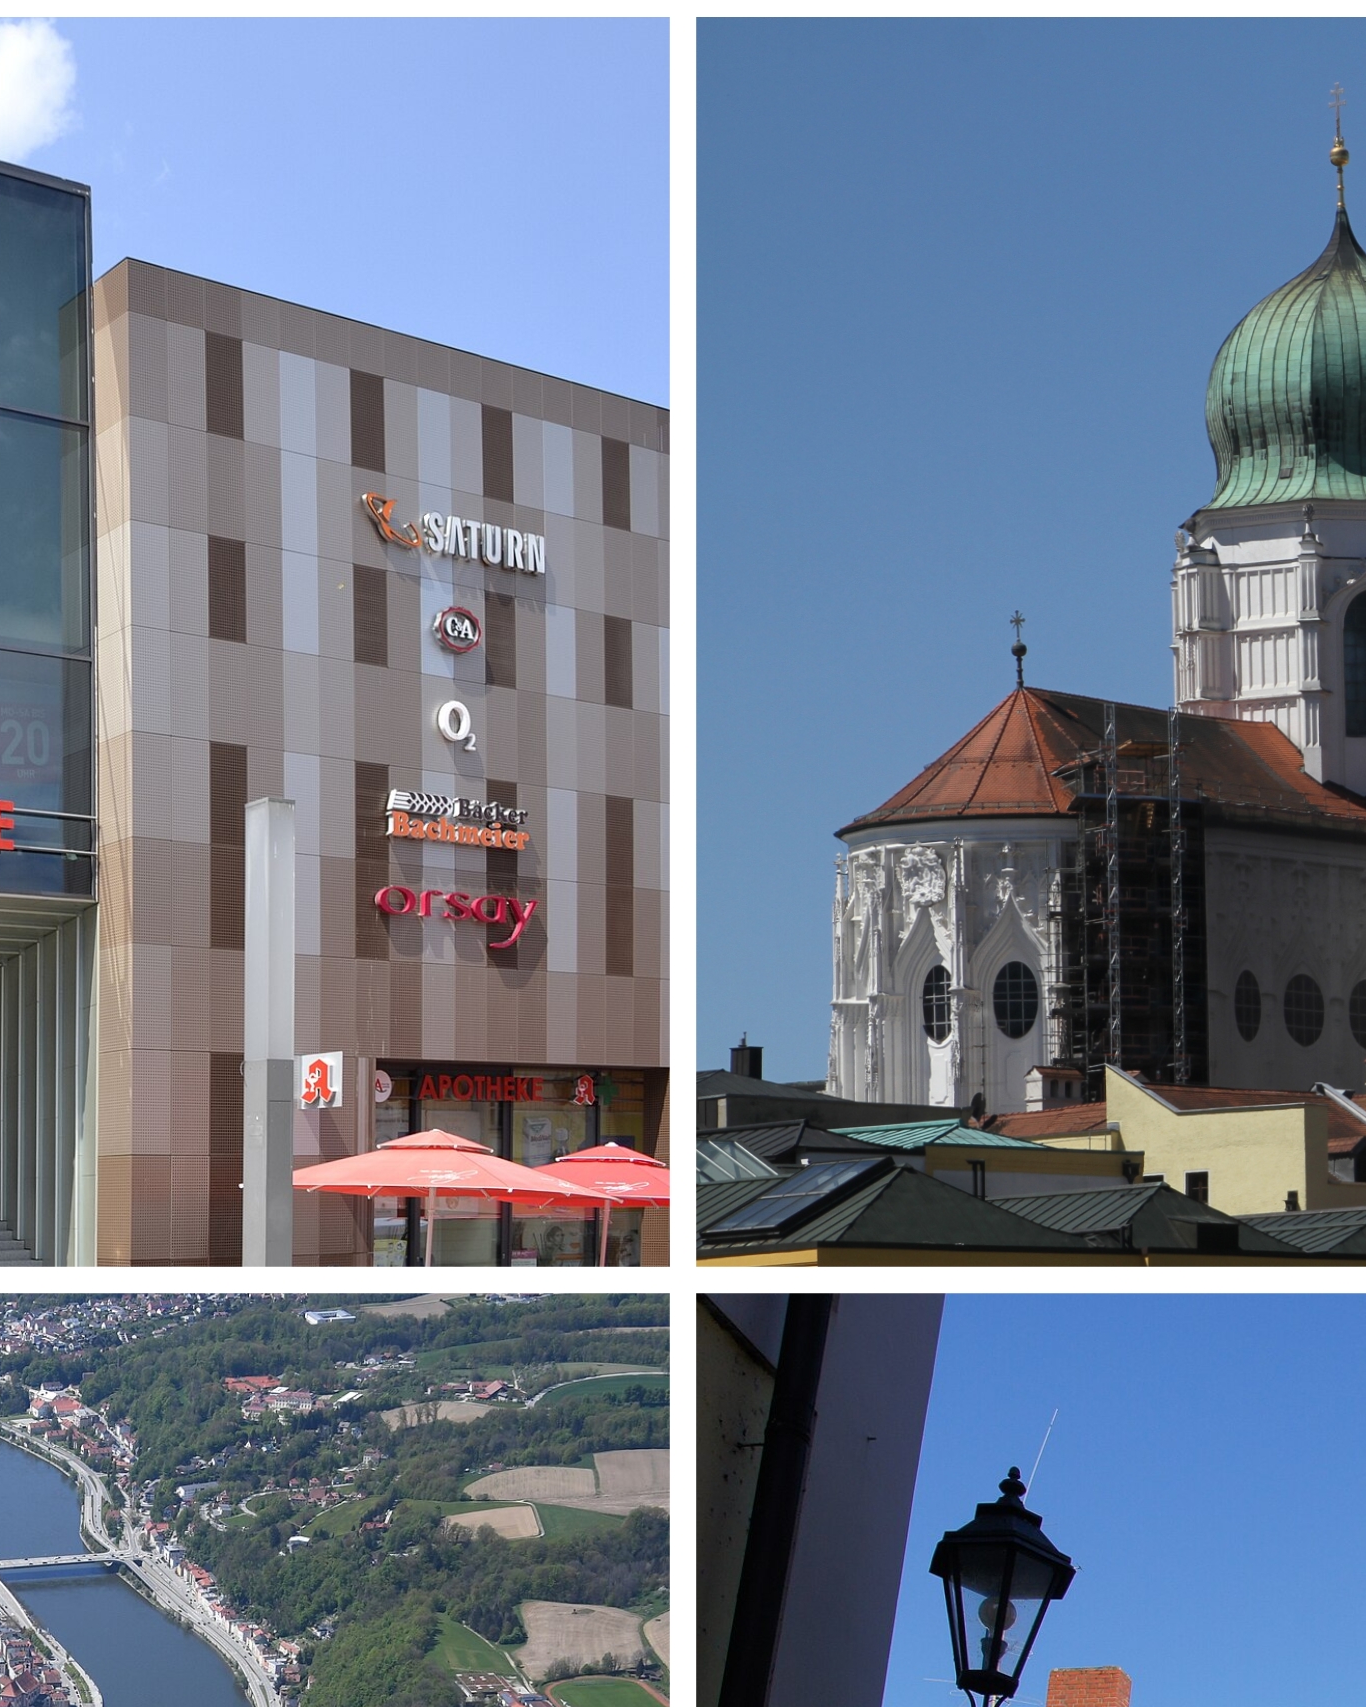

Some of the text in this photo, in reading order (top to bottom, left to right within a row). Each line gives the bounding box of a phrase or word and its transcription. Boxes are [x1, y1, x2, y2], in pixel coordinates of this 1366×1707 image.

[424, 511, 545, 574] SATURN
[445, 617, 475, 641] C&A
[0, 719, 50, 766] 20
[389, 810, 530, 850] Bachmeier
[455, 798, 529, 825] Bäcker
[375, 885, 539, 948] orsay
[418, 1074, 544, 1101] APOTHEKE
